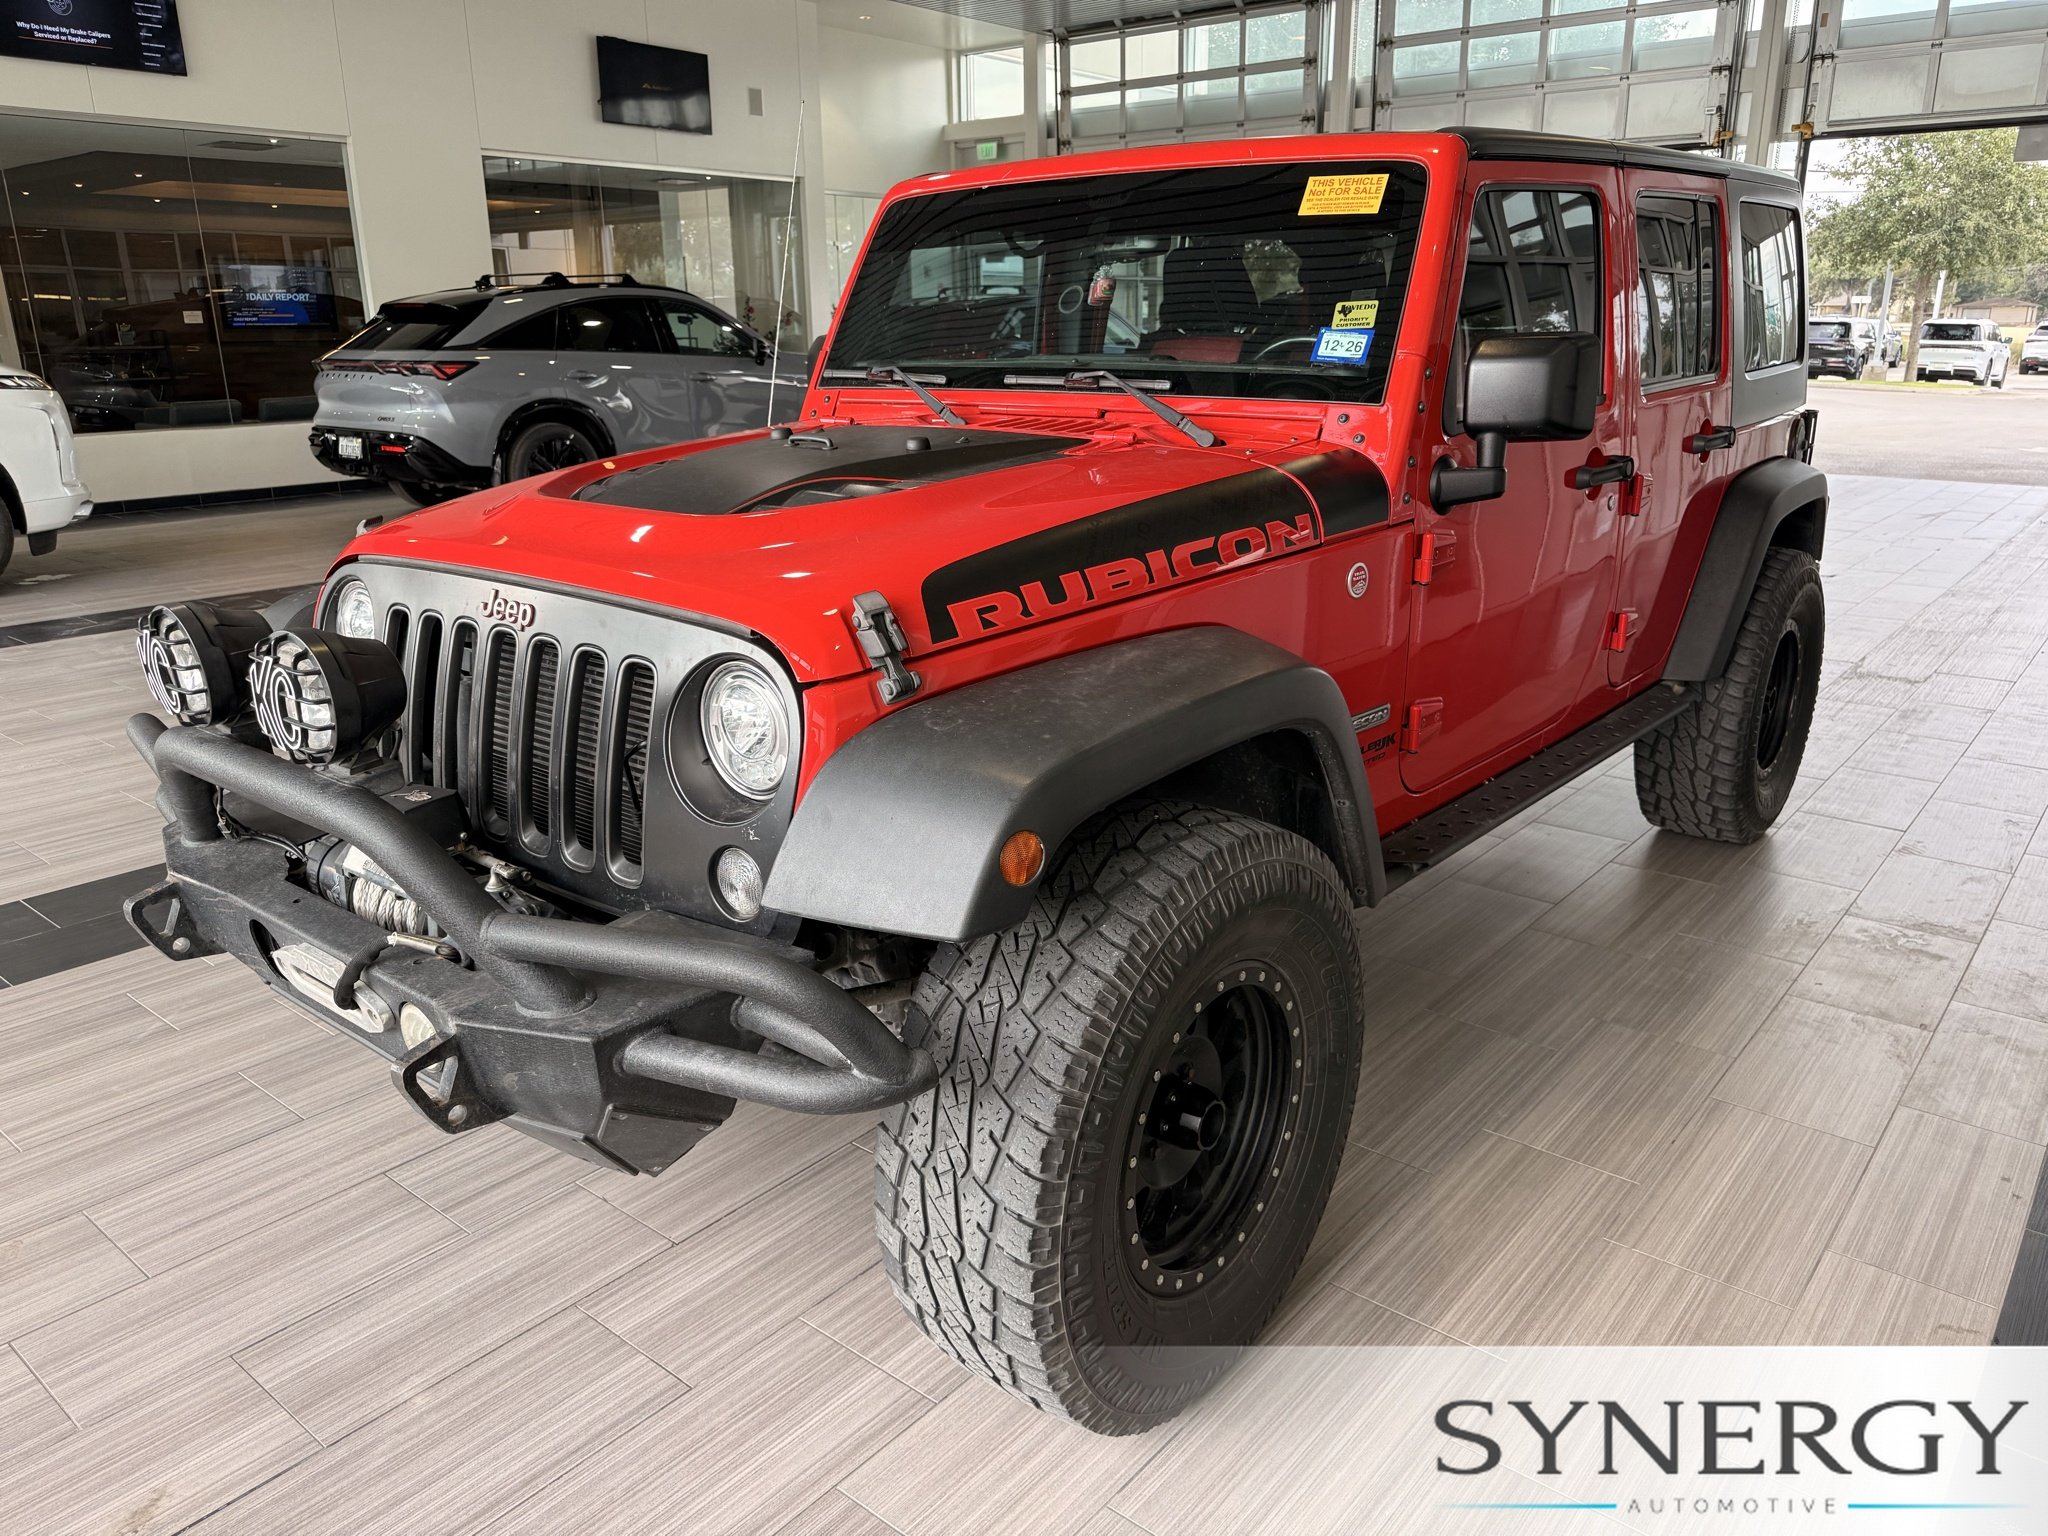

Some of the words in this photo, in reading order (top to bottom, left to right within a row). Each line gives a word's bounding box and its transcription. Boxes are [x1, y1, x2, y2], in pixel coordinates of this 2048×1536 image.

[16, 21, 30, 29] Why
[44, 24, 59, 32] Need
[88, 30, 111, 39] Calipers
[34, 31, 60, 40] Serviced
[67, 35, 97, 44] Replaced?
[1312, 178, 1335, 187] THIS
[1338, 177, 1384, 186] VEHICLE
[1308, 188, 1326, 197] Not
[1328, 187, 1350, 196] FOR
[1353, 186, 1382, 195] SALE
[250, 293, 274, 301] DAILY
[275, 293, 310, 302] REPORT
[947, 513, 1320, 638] RUBICON
[480, 588, 536, 632] Jeep
[249, 655, 303, 753] KC
